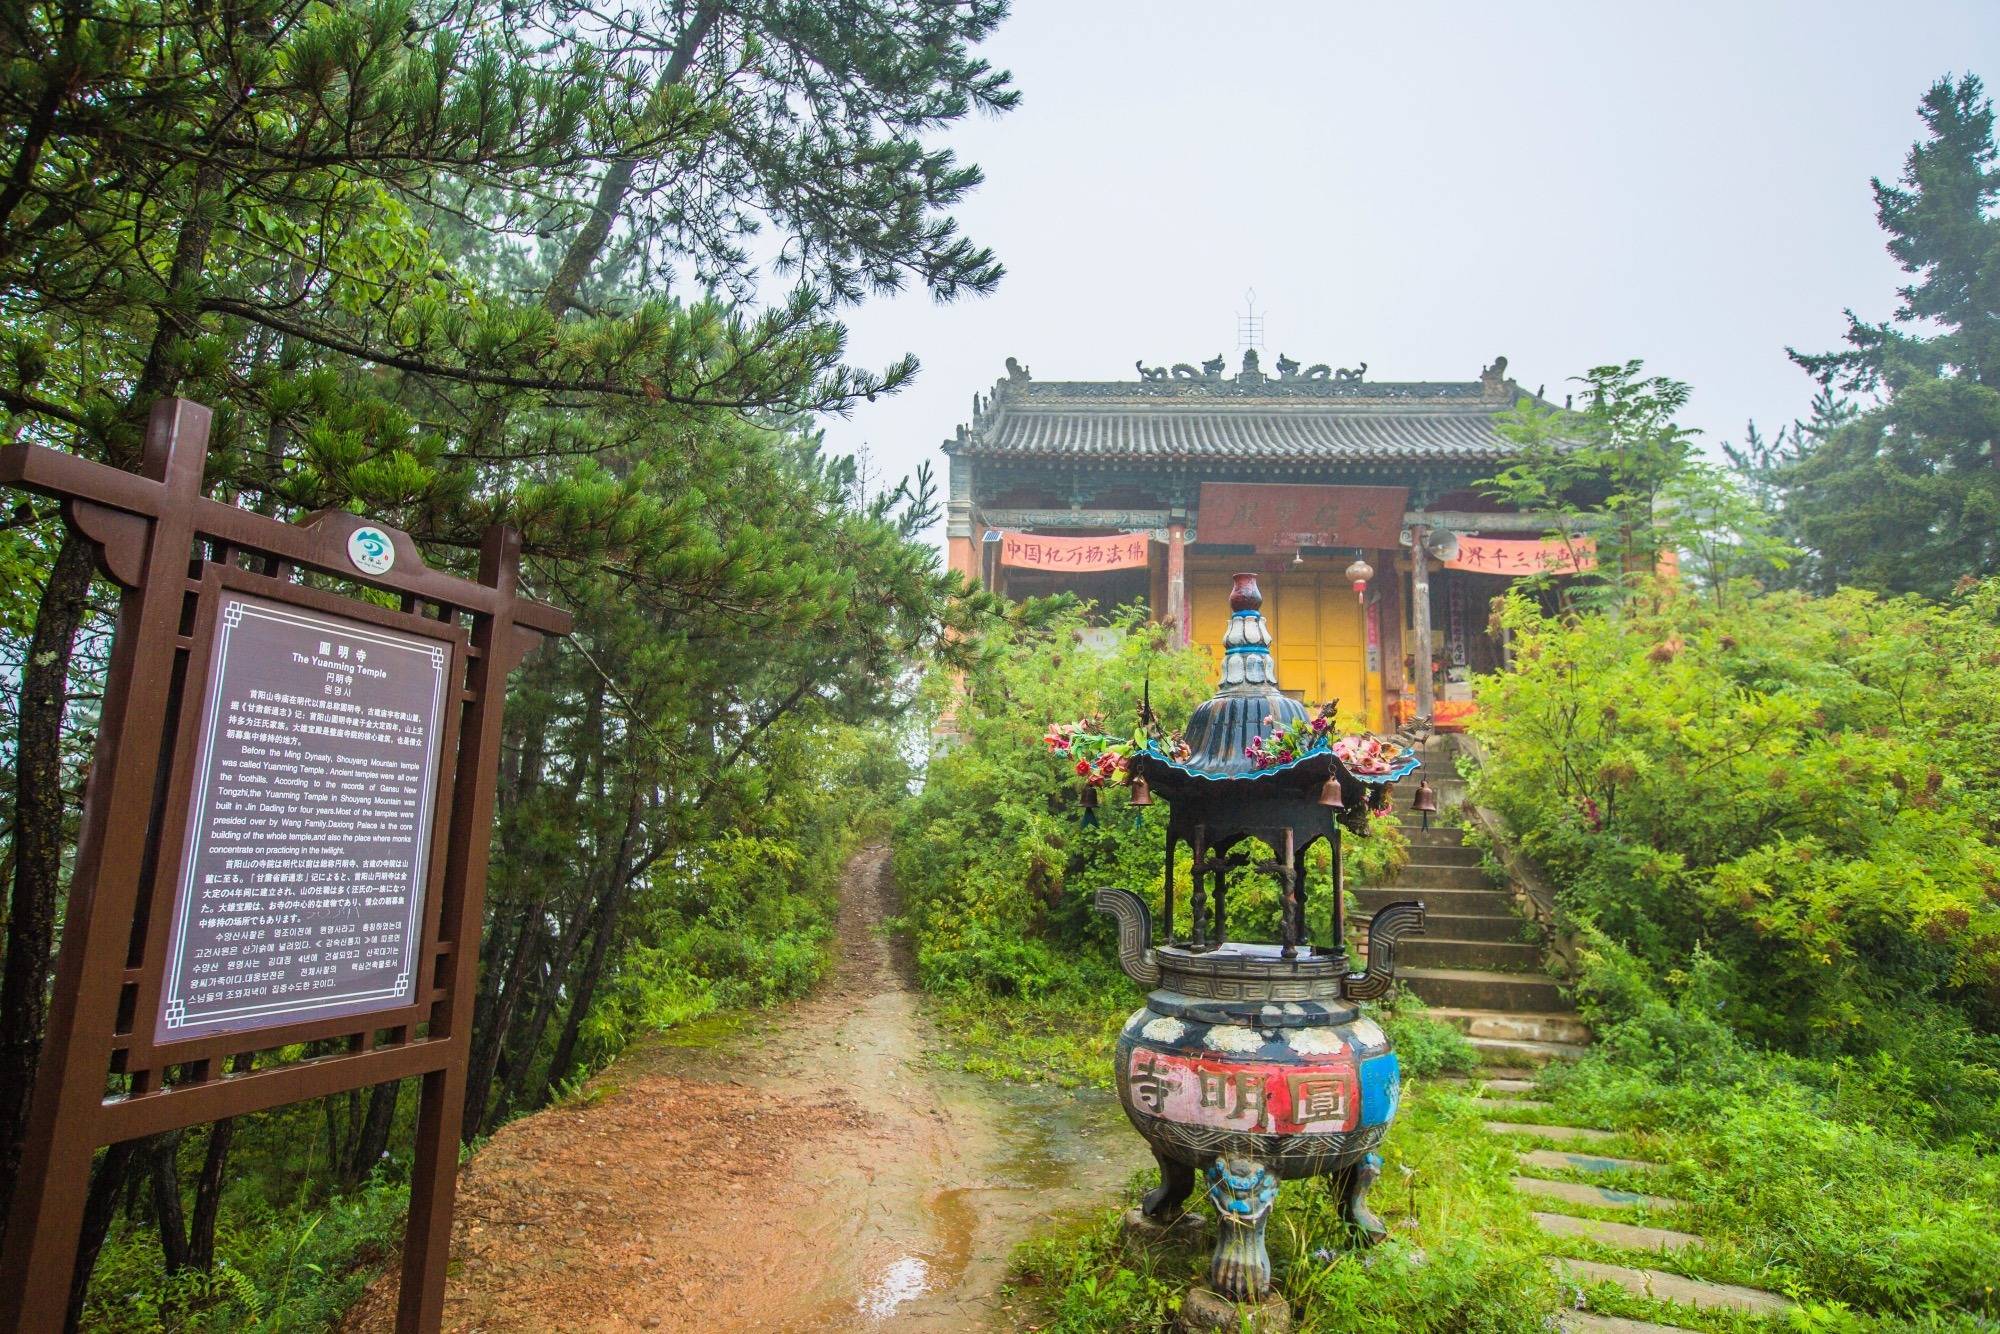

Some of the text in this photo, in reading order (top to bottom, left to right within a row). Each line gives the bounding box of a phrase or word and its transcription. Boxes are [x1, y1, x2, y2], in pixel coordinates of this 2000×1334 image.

[292, 653, 387, 678] The Yuanming Temple
[242, 746, 266, 755] Before
[285, 750, 302, 760] Ming
[337, 755, 368, 766] Shouyang
[371, 759, 398, 767] Mountain
[401, 762, 420, 770] temple
[239, 760, 262, 769] called
[263, 762, 298, 773] Yuanming
[300, 765, 325, 775] Temple
[330, 768, 354, 776] Ancient
[355, 771, 379, 779] temples
[220, 773, 233, 781] the
[274, 777, 309, 788] According
[266, 790, 301, 801] Yuanming
[304, 792, 329, 802] Temple
[341, 795, 372, 805] Shouyang
[374, 797, 402, 805] Mountain
[216, 801, 233, 809] built
[260, 804, 285, 814] Dading
[375, 810, 398, 818] temples
[213, 817, 247, 825] presided
[269, 818, 279, 827] by
[282, 819, 302, 828] Wang
[357, 821, 378, 829] Palace
[211, 831, 242, 840] building
[267, 832, 288, 840] whole
[354, 834, 372, 842] place
[266, 846, 300, 855] practicing
